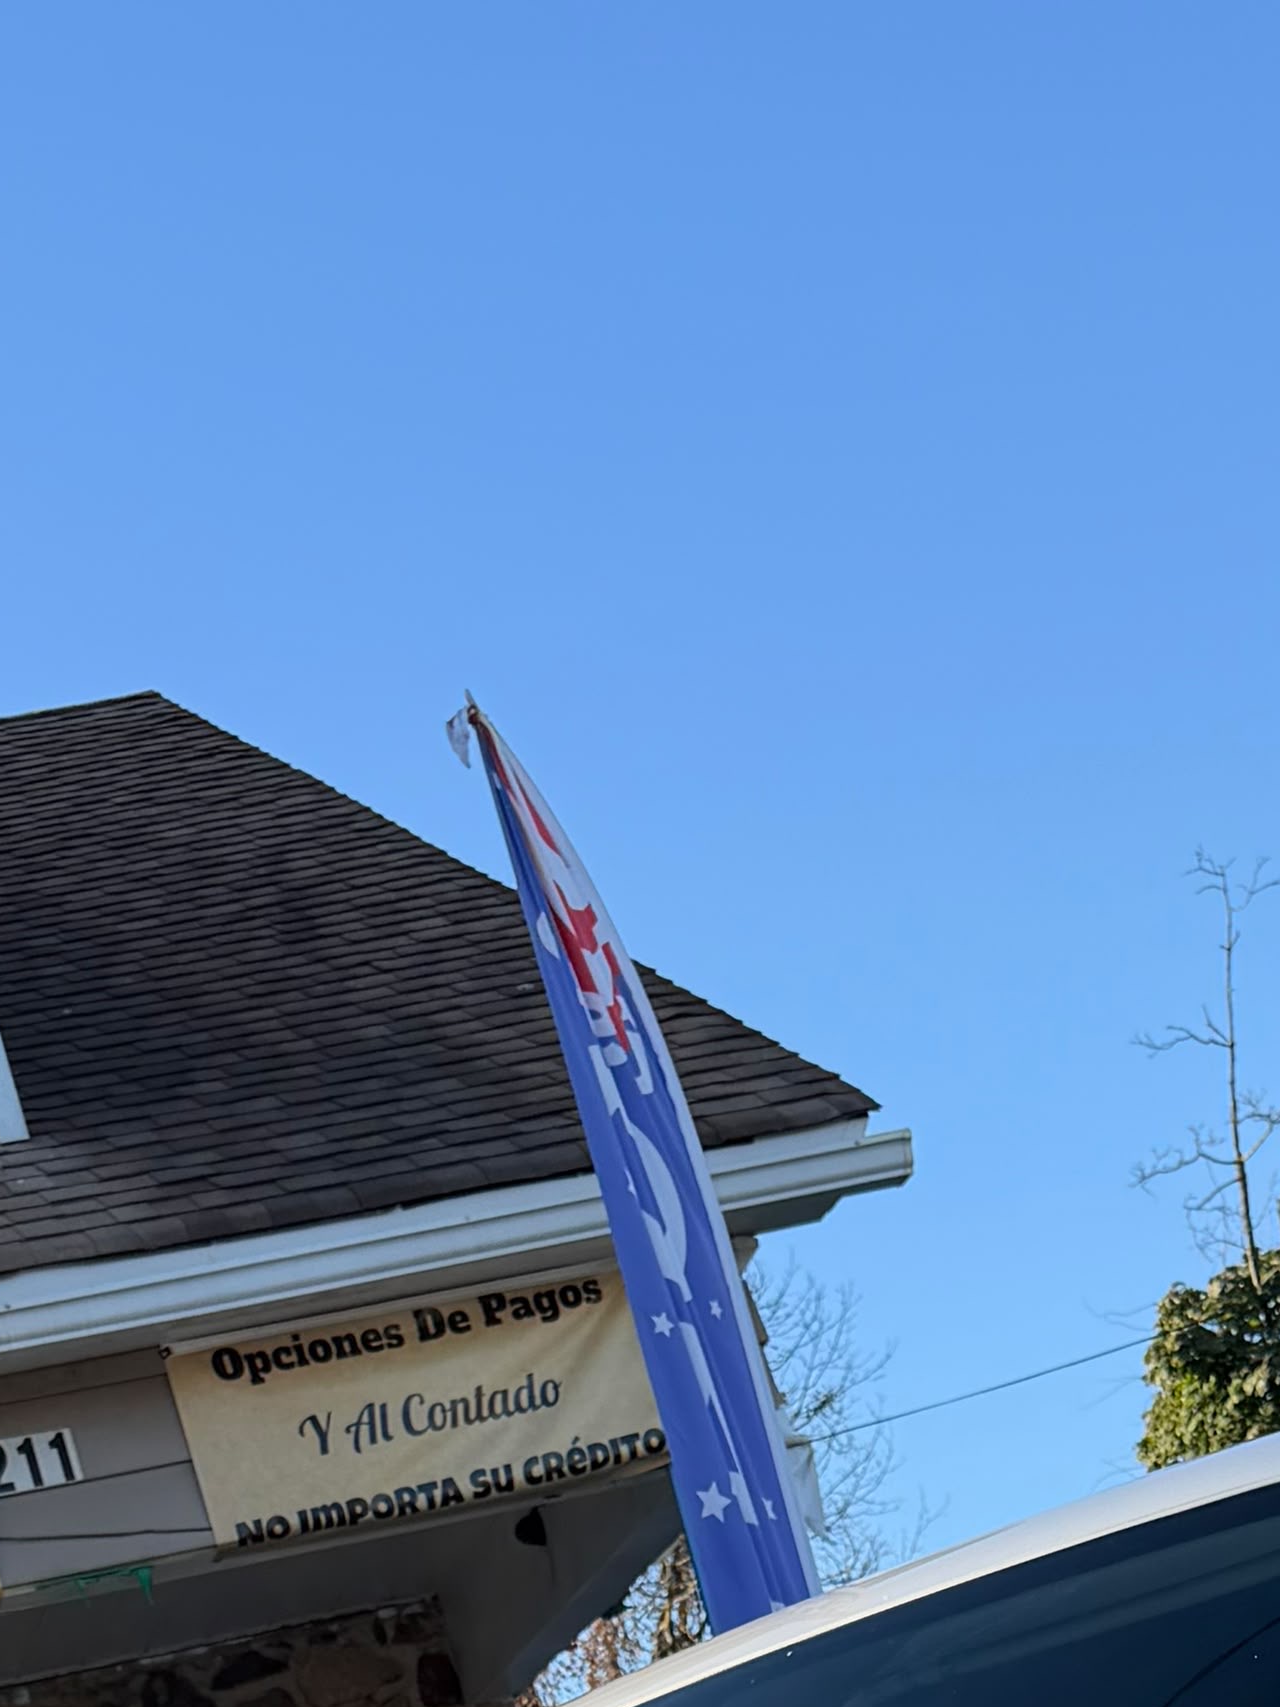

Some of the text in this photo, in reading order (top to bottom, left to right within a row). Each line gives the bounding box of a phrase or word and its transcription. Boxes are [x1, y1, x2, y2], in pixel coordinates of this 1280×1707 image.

[210, 1279, 603, 1385] Opciones De Pagos
[297, 1372, 563, 1456] Y Al Contado
[234, 1514, 291, 1547] NO
[297, 1476, 464, 1535] IMPORTA
[469, 1463, 515, 1499] SU
